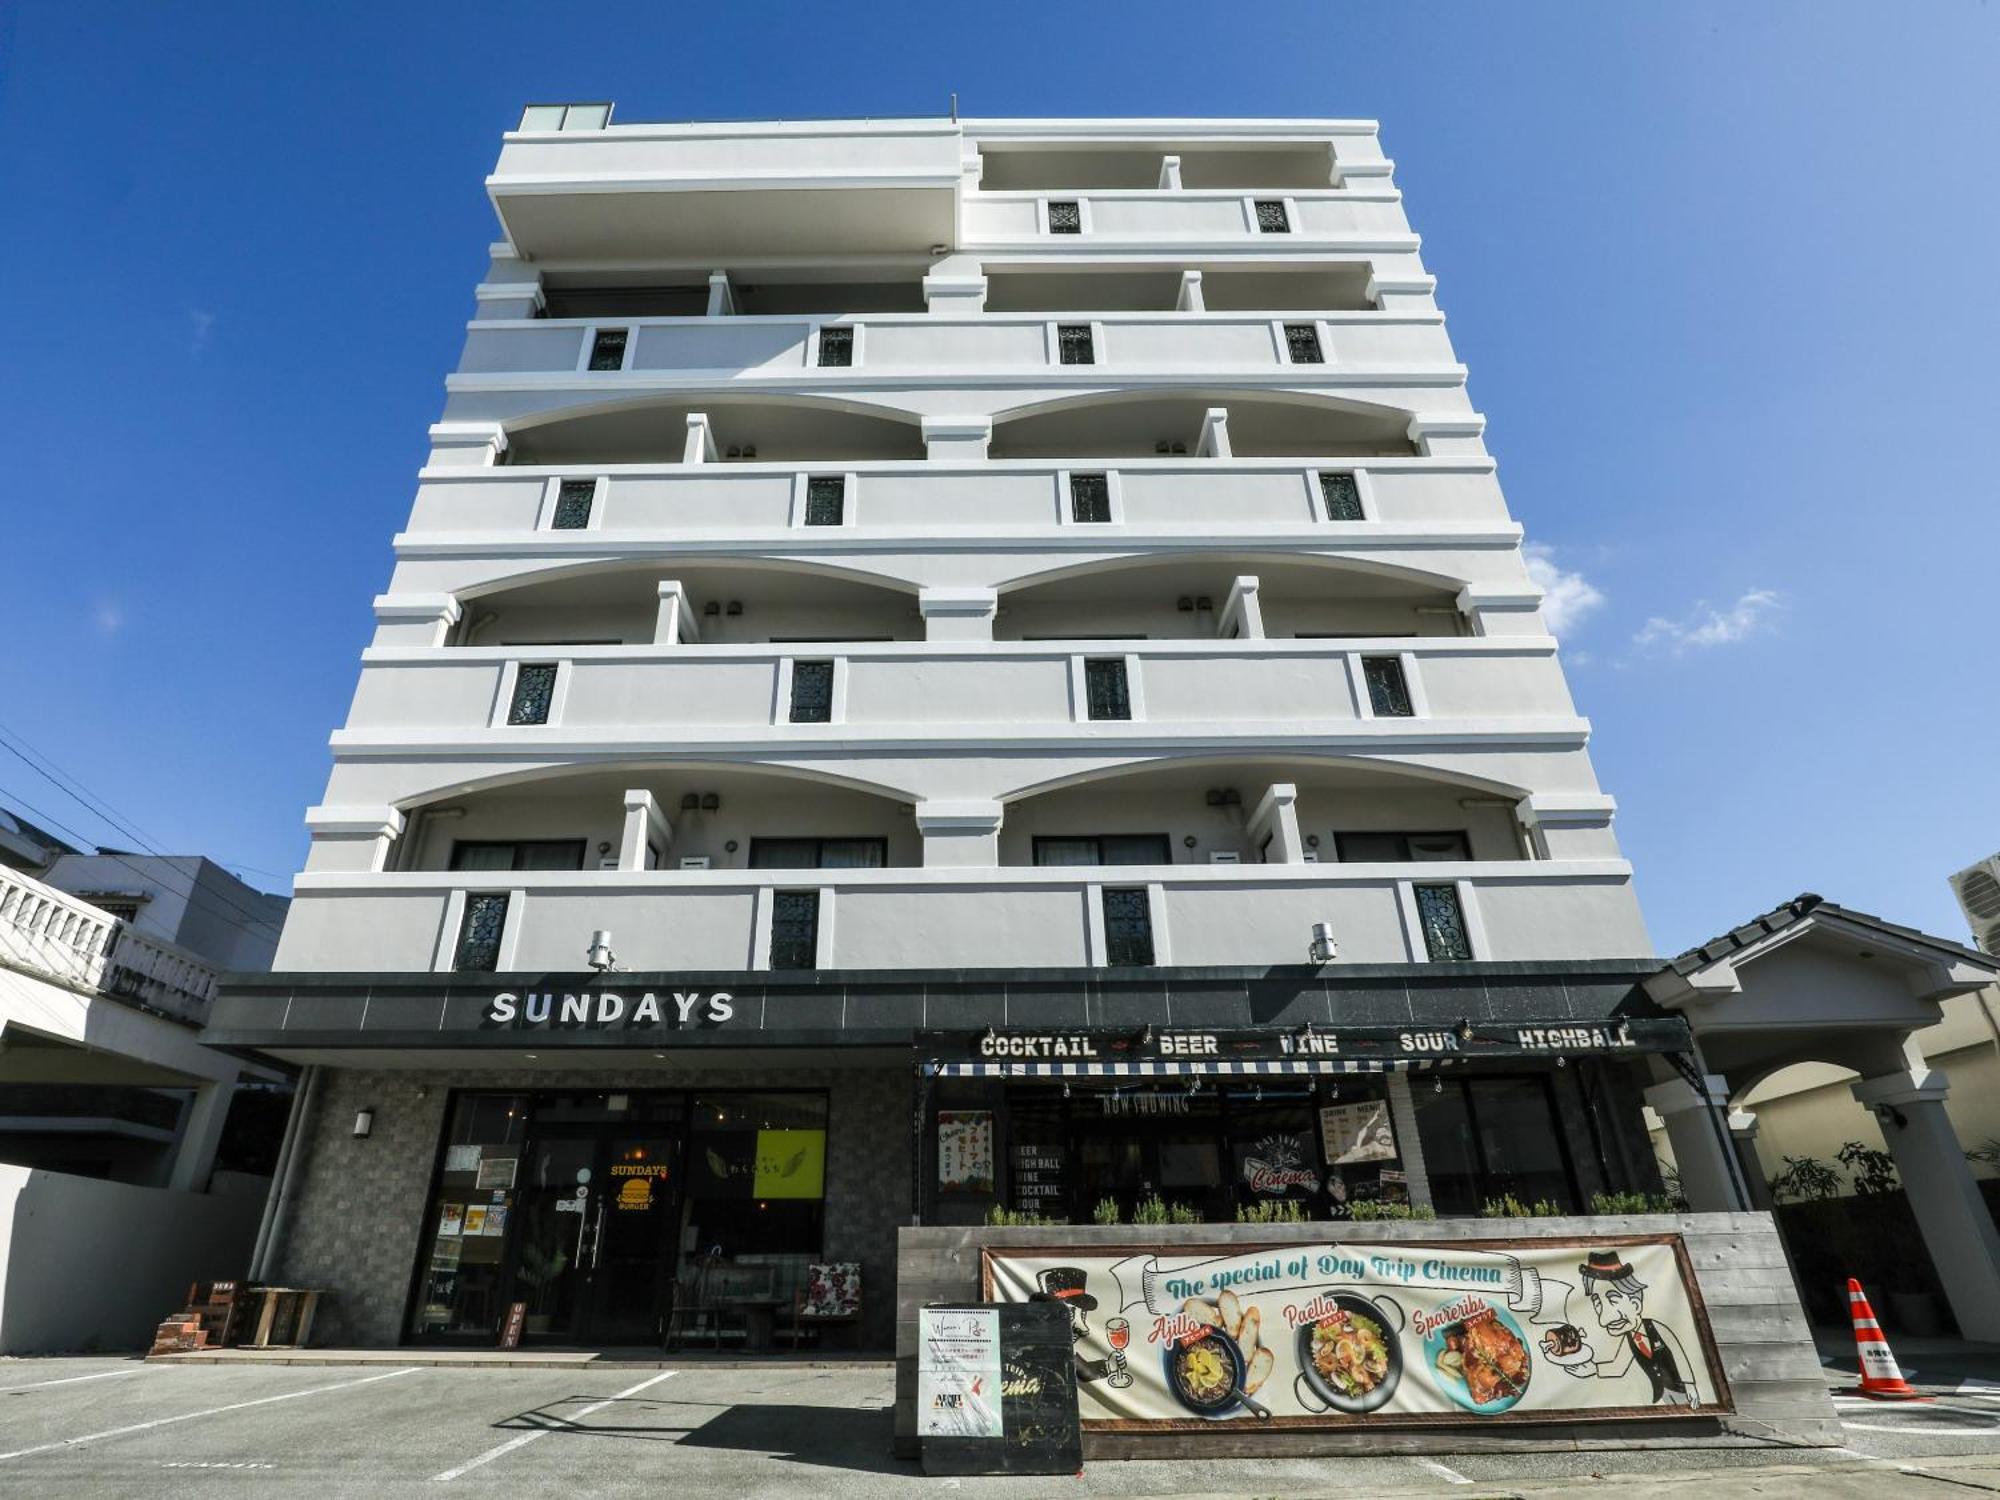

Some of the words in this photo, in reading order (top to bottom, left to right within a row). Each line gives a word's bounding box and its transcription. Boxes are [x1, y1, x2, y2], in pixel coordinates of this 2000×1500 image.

[490, 993, 733, 1022] SUNDAYS
[981, 1036, 1097, 1056] COCKTAIL
[1160, 1035, 1218, 1054] BEER
[1280, 1034, 1339, 1053] WINE
[1401, 1033, 1459, 1052] SOUR
[1517, 1028, 1636, 1049] HIGHBALL
[1104, 1094, 1129, 1114] NOW
[1133, 1093, 1189, 1113] SHOWING
[610, 1165, 668, 1176] SUNDAYS
[1250, 1168, 1316, 1193] Cinema
[1165, 1278, 1205, 1299] The
[1211, 1258, 1281, 1293] special
[1287, 1256, 1309, 1280] of
[1317, 1255, 1365, 1280] Day
[1370, 1256, 1416, 1282] Trip
[1422, 1259, 1501, 1283] Cinema
[505, 1303, 522, 1347] OPEN
[1283, 1296, 1336, 1329] Paella
[1413, 1294, 1486, 1339] Spareribs
[1148, 1315, 1197, 1347] Ajillo
[1001, 1378, 1041, 1396] ema
